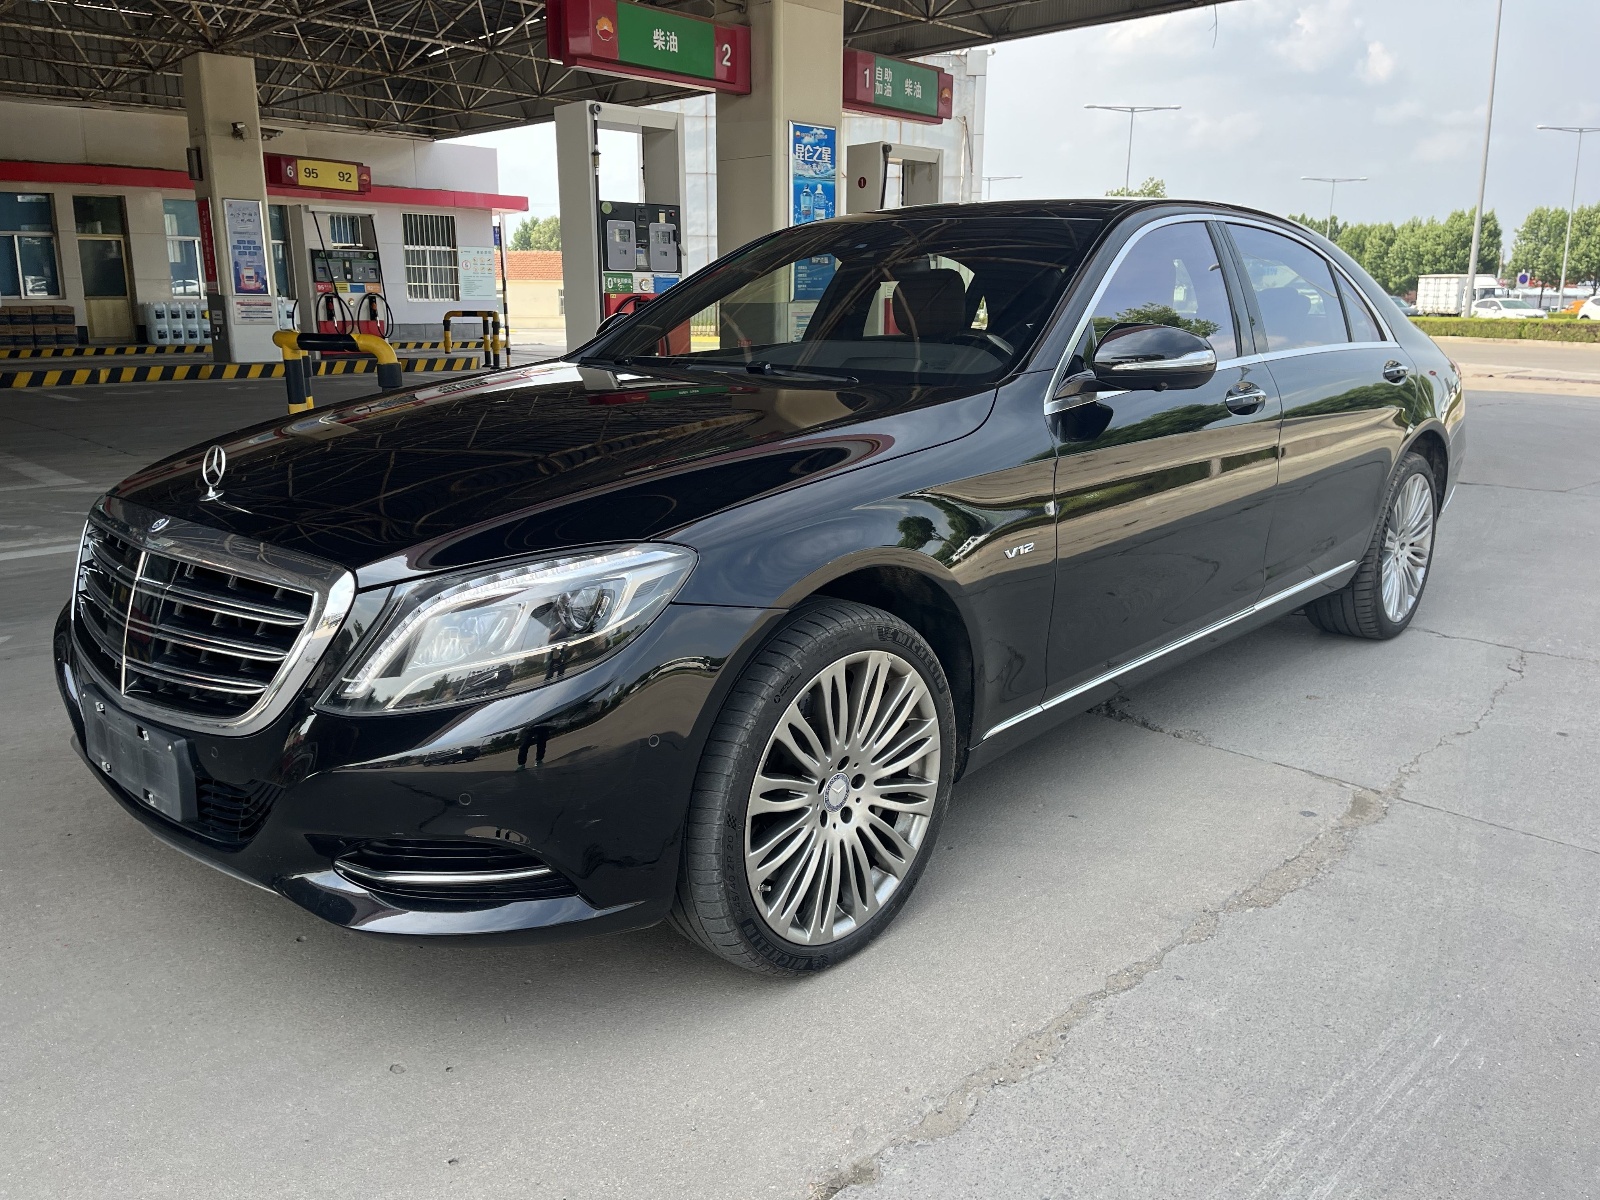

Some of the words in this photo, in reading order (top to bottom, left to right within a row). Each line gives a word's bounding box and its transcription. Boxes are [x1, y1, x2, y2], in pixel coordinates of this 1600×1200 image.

[653, 28, 679, 53] 柴油
[721, 43, 732, 67] 2
[863, 68, 870, 89] 1
[875, 66, 893, 82] 自助
[874, 81, 893, 97] 加油
[904, 78, 922, 99] 柴油
[795, 143, 832, 164] 昆仑之星
[286, 165, 294, 178] 6
[303, 167, 319, 179] 95
[337, 171, 352, 183] 92
[1004, 541, 1035, 559] V12
[895, 631, 945, 690] MICHELIN
